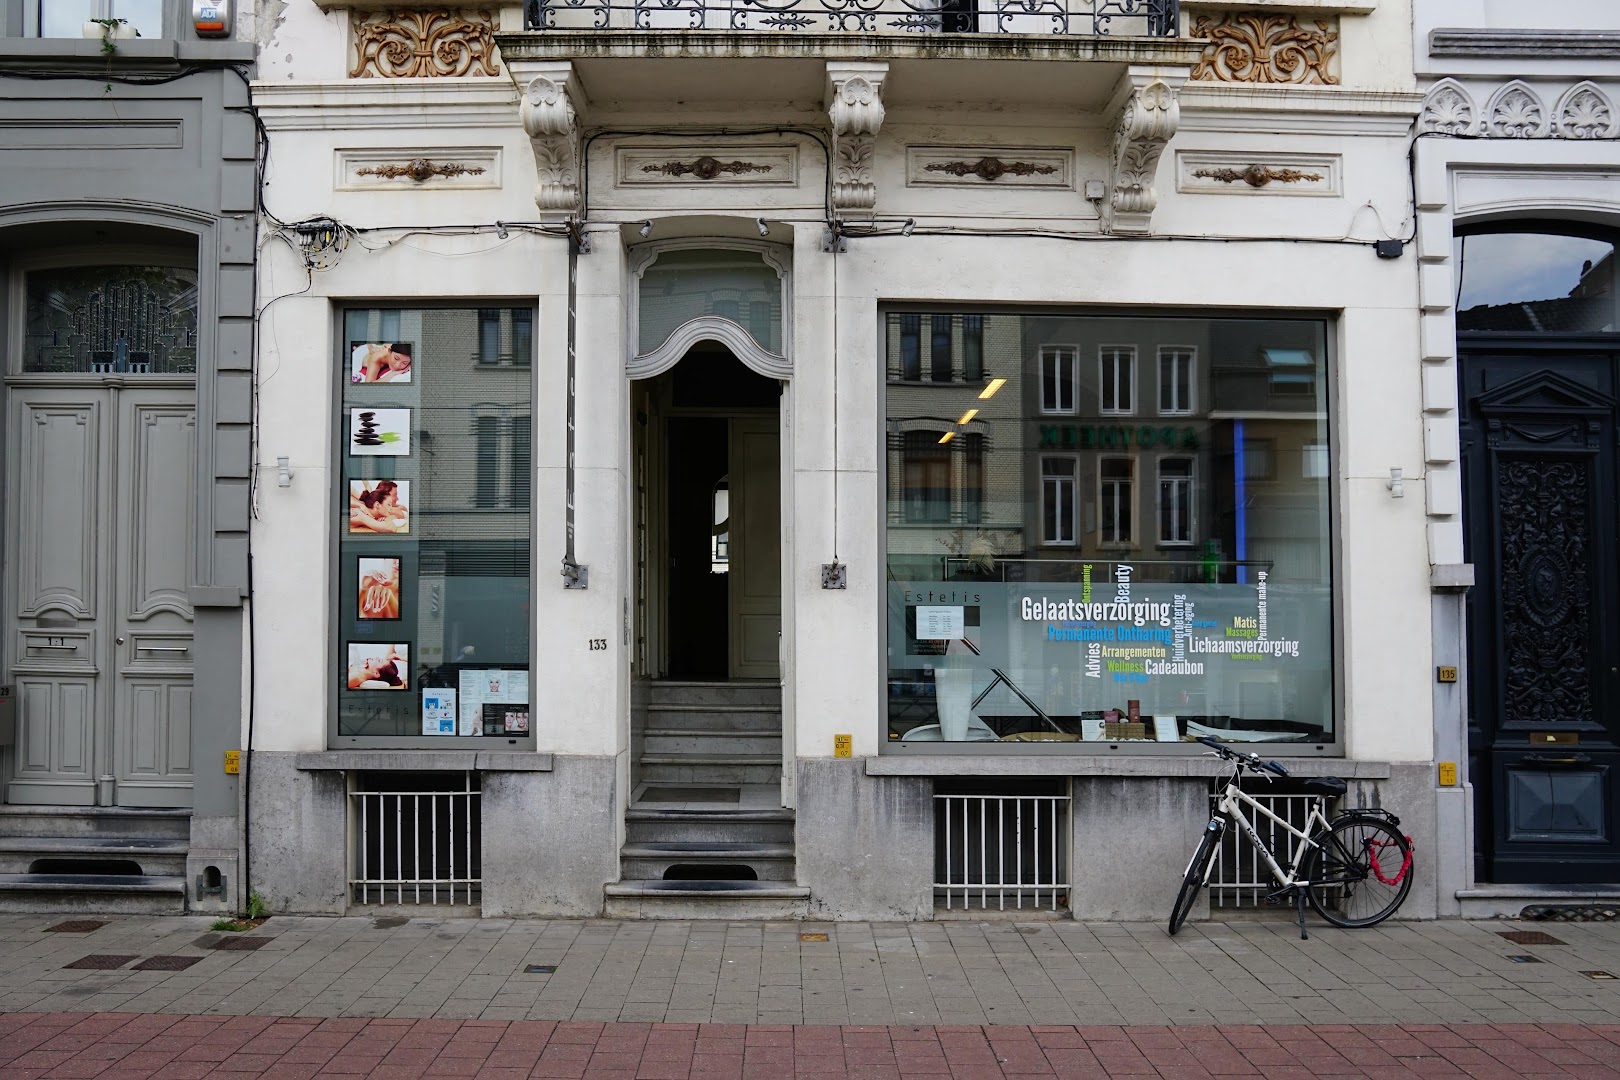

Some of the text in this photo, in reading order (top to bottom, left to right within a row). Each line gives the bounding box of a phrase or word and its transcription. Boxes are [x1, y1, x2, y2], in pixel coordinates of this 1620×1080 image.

[201, 8, 216, 19] ADT
[1081, 564, 1093, 603] Ontspanning
[1114, 564, 1133, 603] Beauty
[904, 590, 981, 603] Estetis
[1256, 571, 1268, 641] Permanente make-up
[1021, 596, 1171, 627] Gelaatsverzorging
[1184, 602, 1195, 637] Anti-aging
[1171, 593, 1187, 662] Huidverbetering
[1233, 616, 1257, 629] Matis
[1047, 625, 1172, 647] Permanente Ontharing
[1225, 627, 1258, 639] Massages
[588, 638, 607, 651] 133
[1101, 645, 1166, 661] Arrangementen
[1189, 637, 1300, 657] Lichaamsverzorging
[1085, 642, 1101, 678] Advies
[1107, 660, 1144, 673] Wellness
[1144, 659, 1204, 675] Cadeaubon
[1442, 669, 1455, 679] 135
[1246, 827, 1269, 858] KOGA
